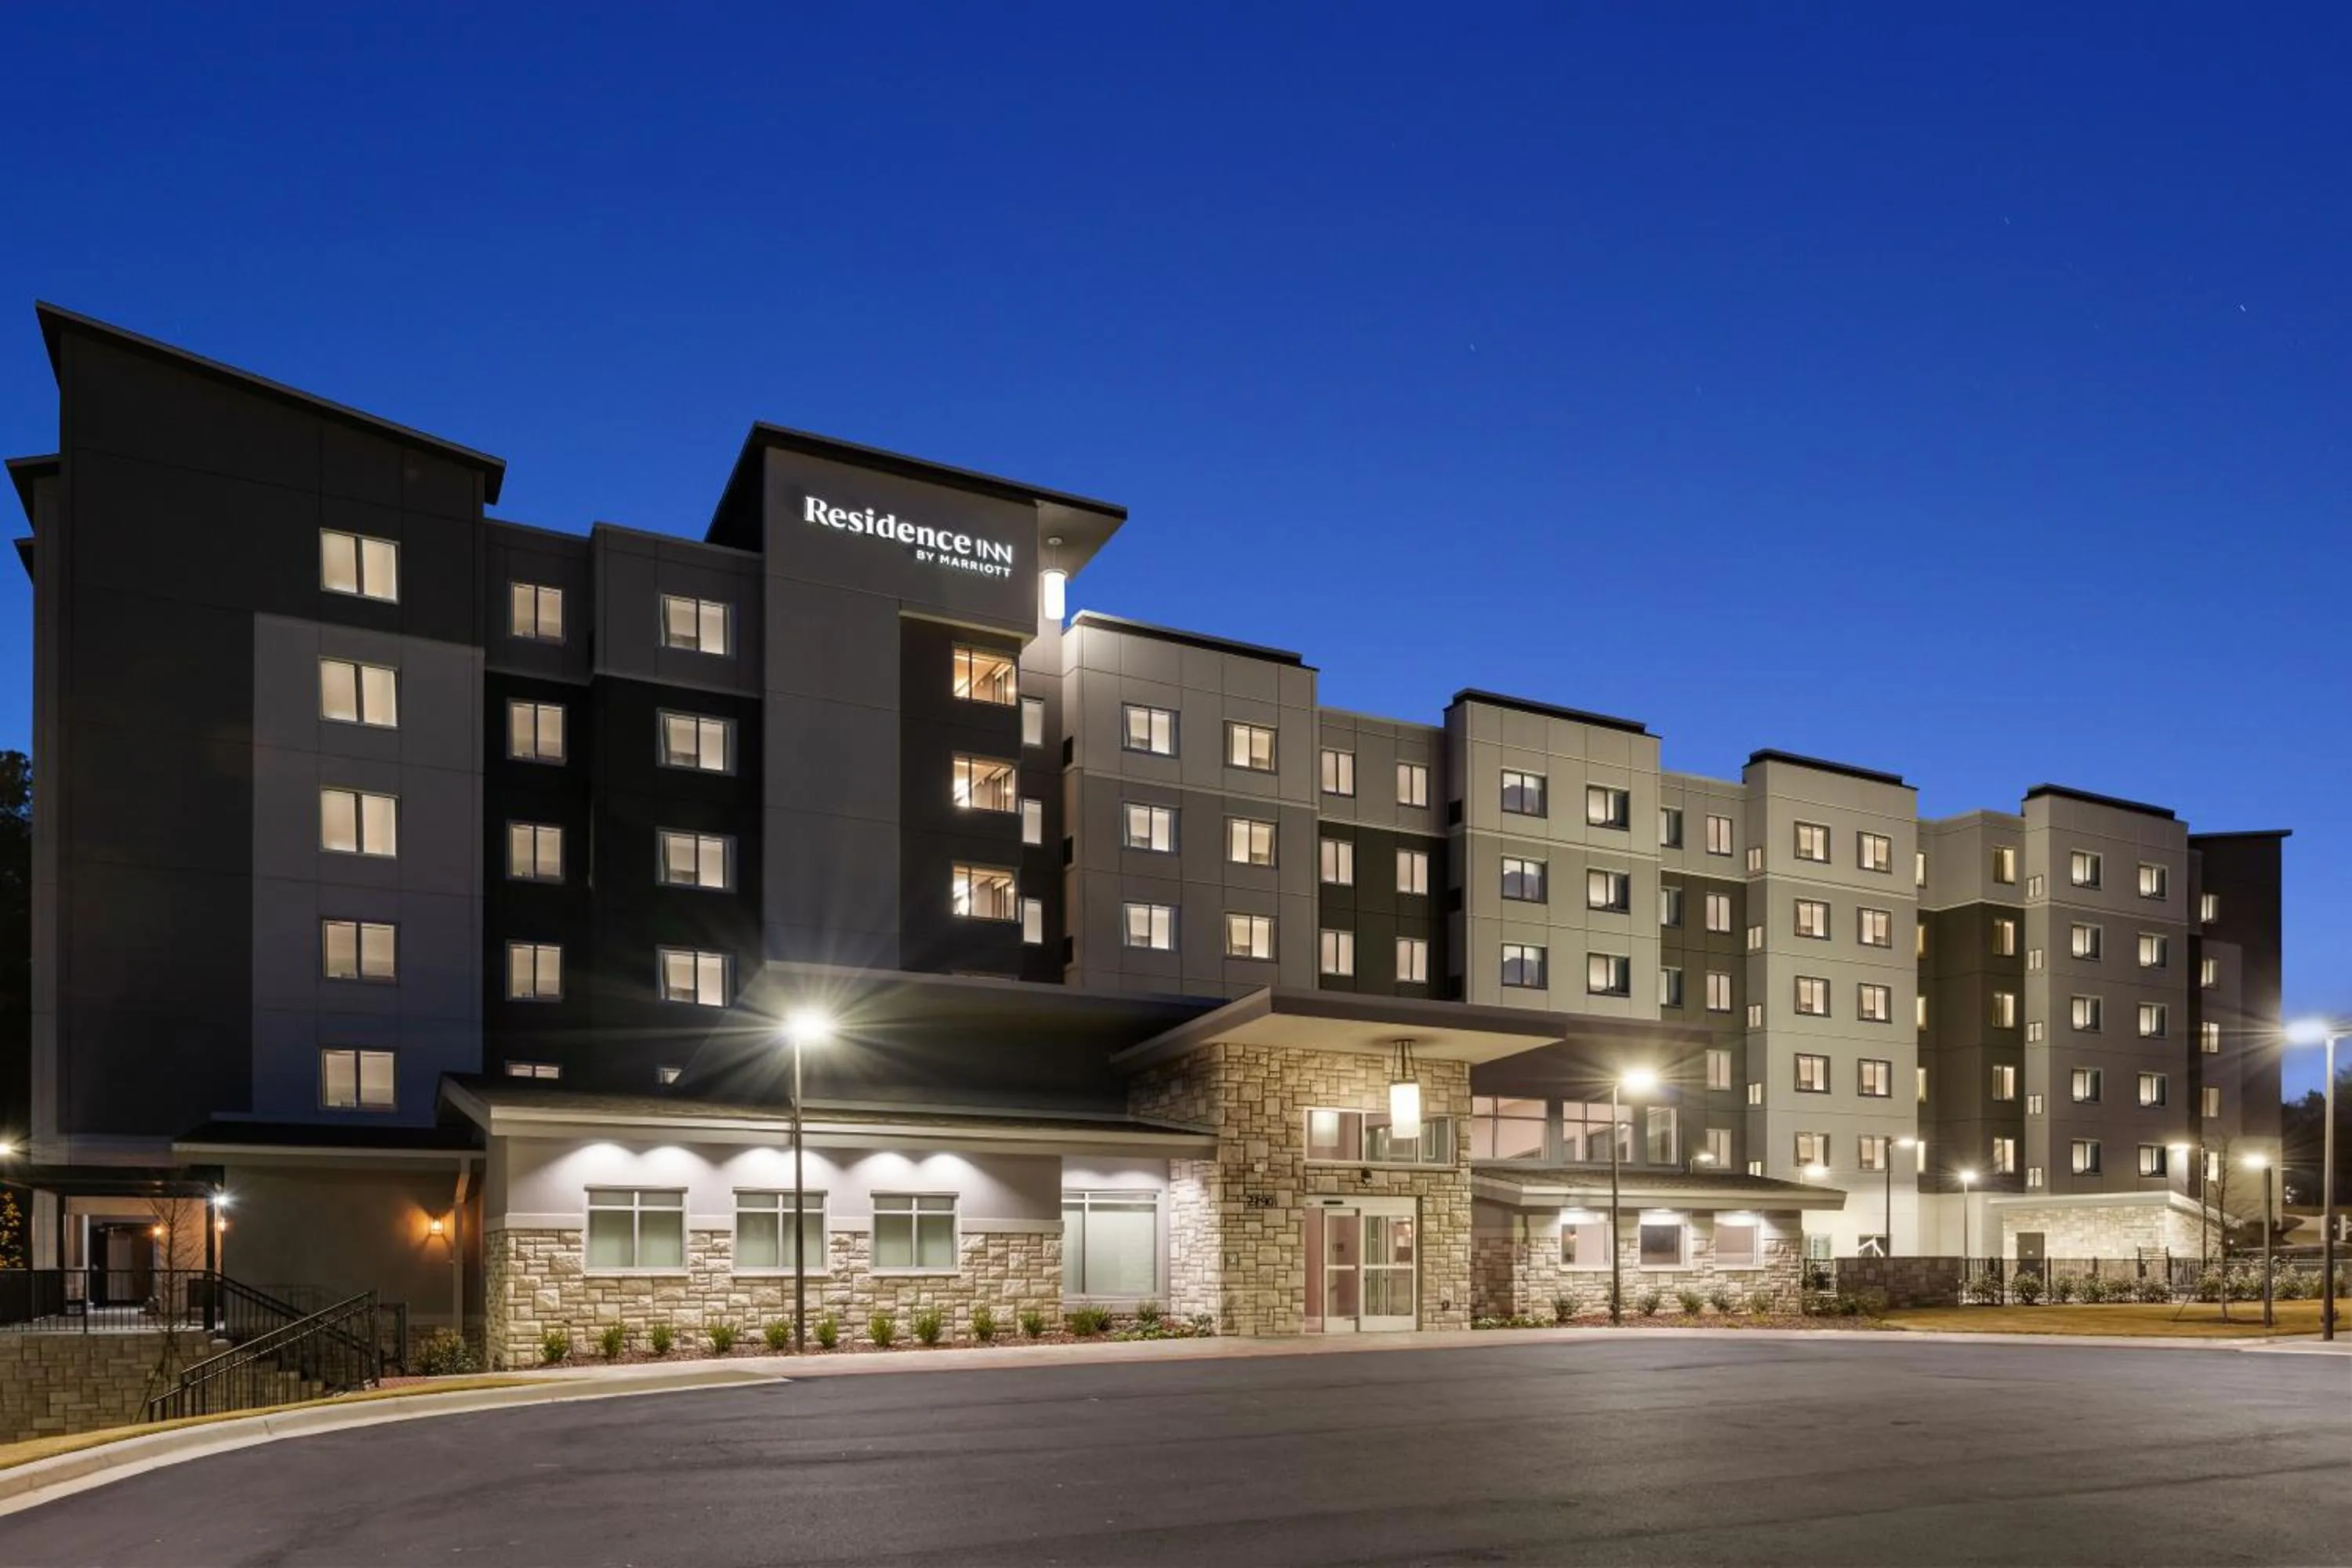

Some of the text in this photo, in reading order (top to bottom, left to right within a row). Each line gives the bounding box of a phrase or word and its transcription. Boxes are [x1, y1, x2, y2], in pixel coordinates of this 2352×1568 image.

[804, 495, 1013, 564] Residence INN
[916, 550, 1011, 578] BY MARRIOTT
